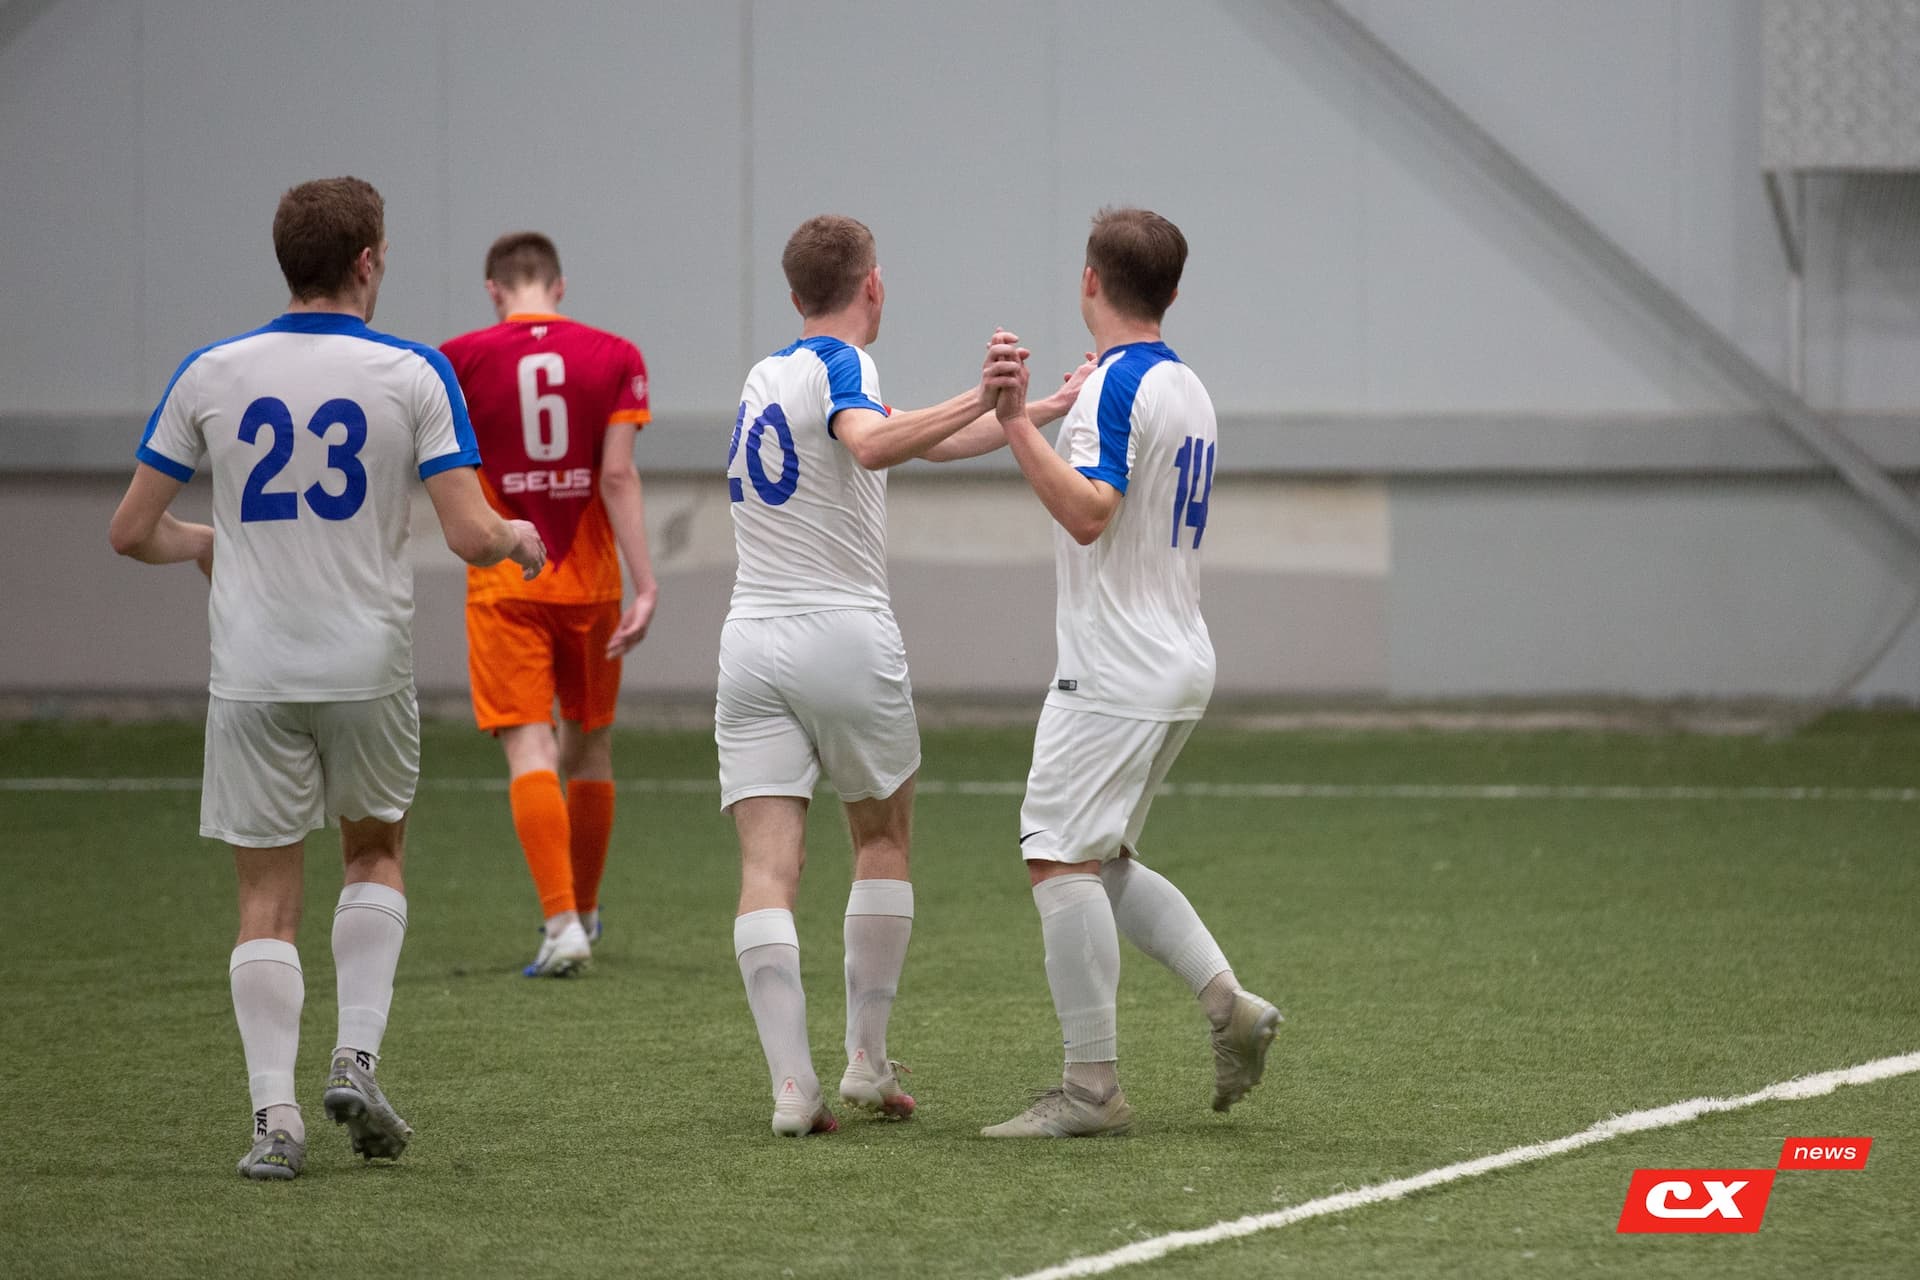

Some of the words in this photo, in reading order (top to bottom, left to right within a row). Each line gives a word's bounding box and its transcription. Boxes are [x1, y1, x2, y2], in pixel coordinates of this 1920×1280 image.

[237, 396, 368, 523] 23
[517, 352, 569, 462] 6
[1171, 436, 1215, 549] 14
